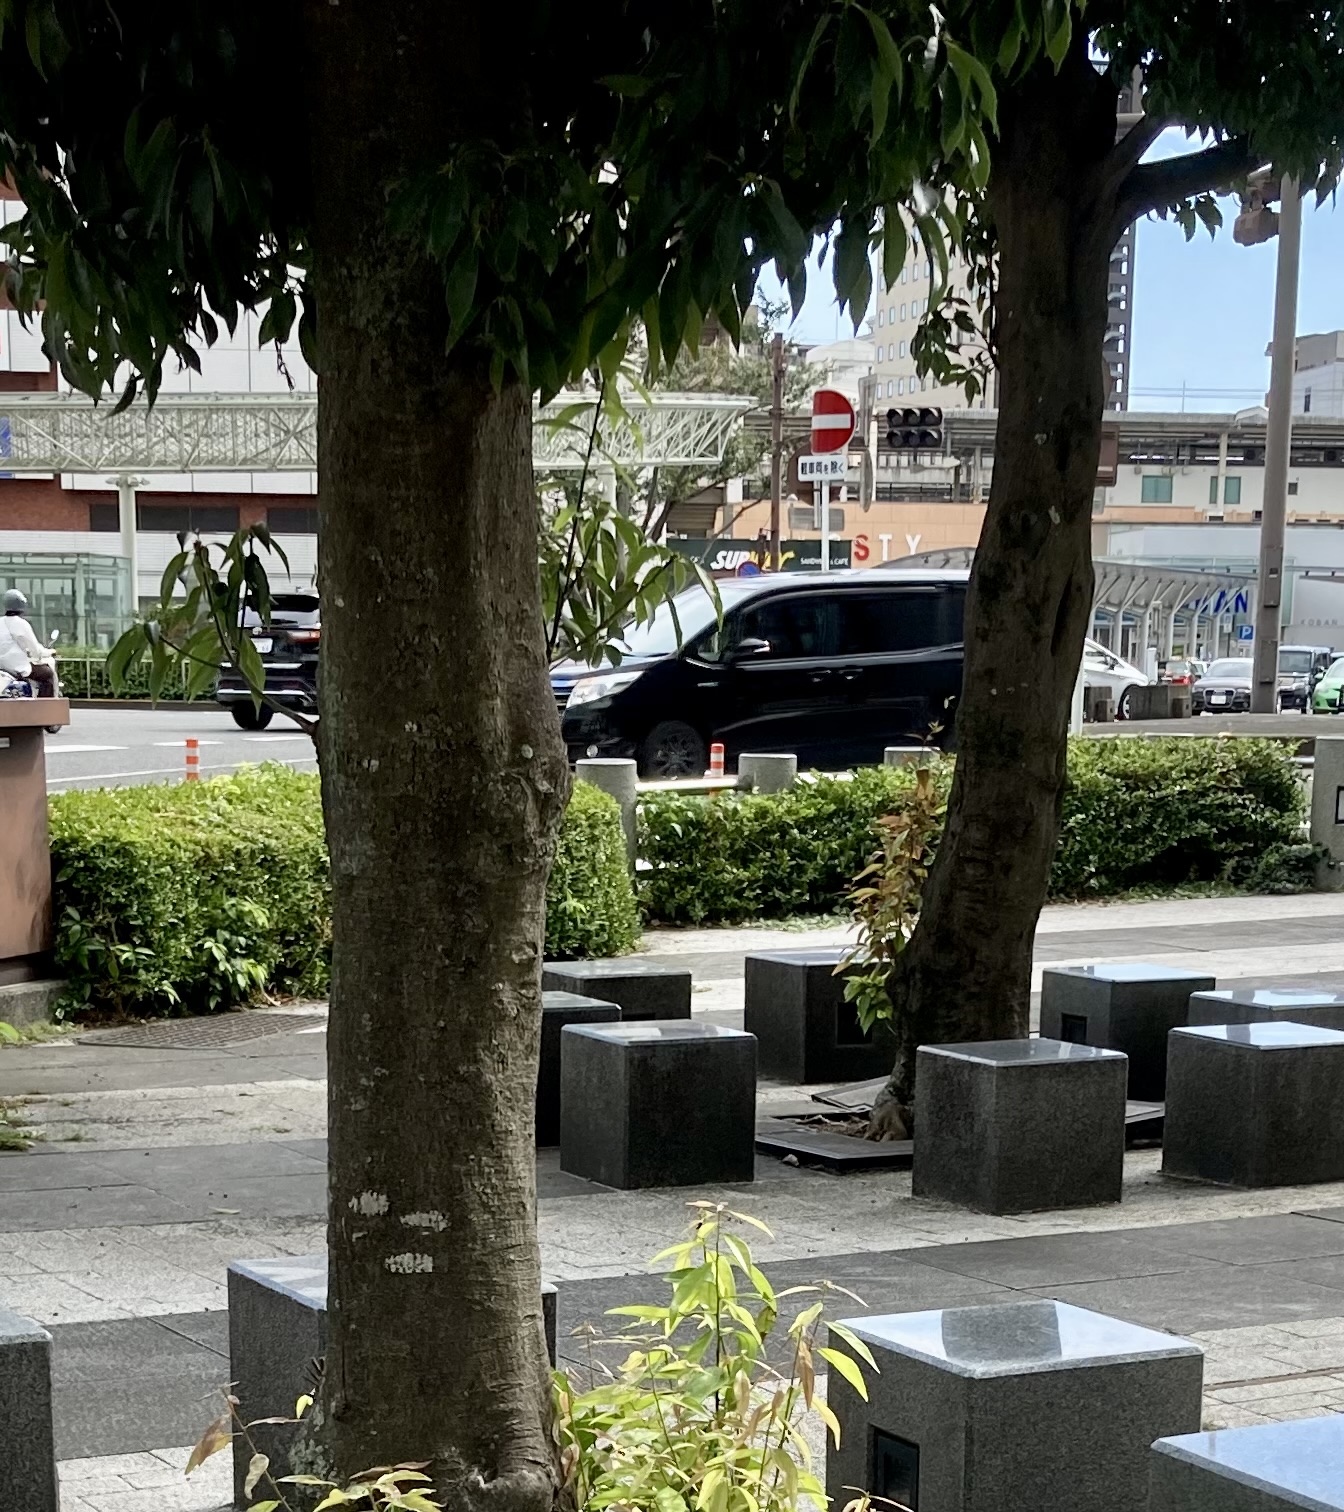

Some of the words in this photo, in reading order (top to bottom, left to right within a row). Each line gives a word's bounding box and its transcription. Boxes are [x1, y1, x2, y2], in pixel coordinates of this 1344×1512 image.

[801, 460, 845, 475] 軽車両を除く
[829, 533, 922, 561] STY
